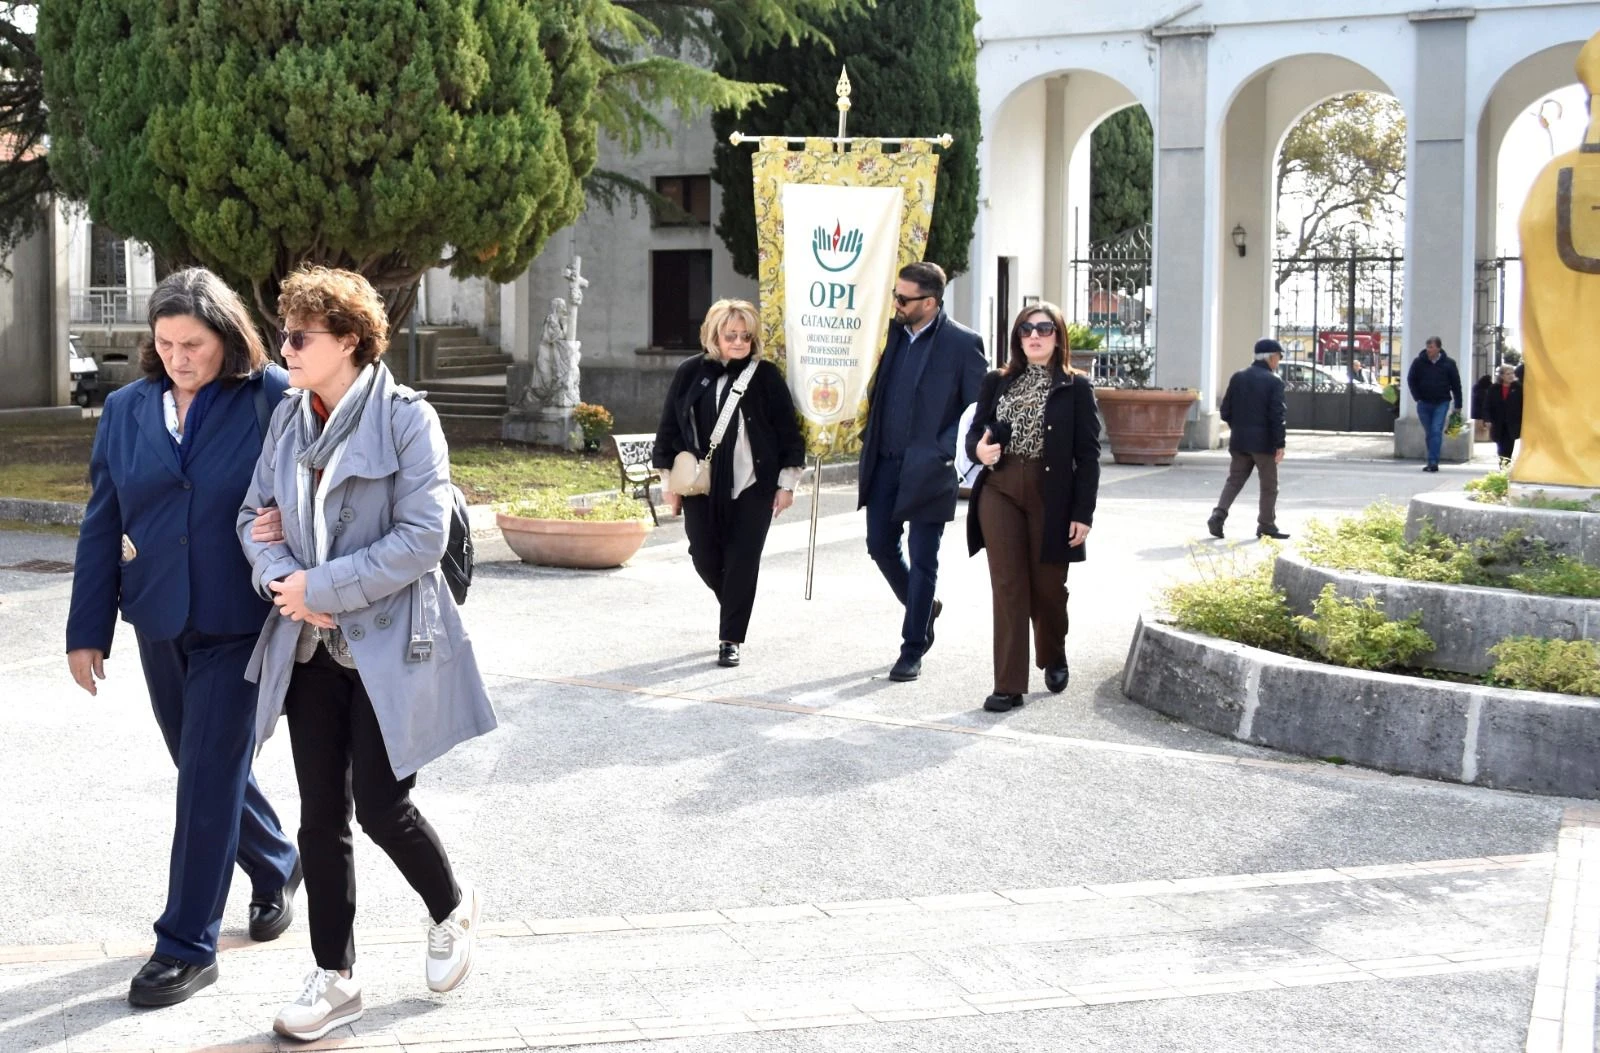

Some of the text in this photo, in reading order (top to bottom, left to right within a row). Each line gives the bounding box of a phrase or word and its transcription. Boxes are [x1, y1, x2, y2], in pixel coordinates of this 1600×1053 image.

[810, 281, 856, 310] OPI
[801, 314, 862, 330] CATANZARO
[807, 333, 853, 345] ORDINE DELLE
[807, 345, 850, 356] PROFESSIONI
